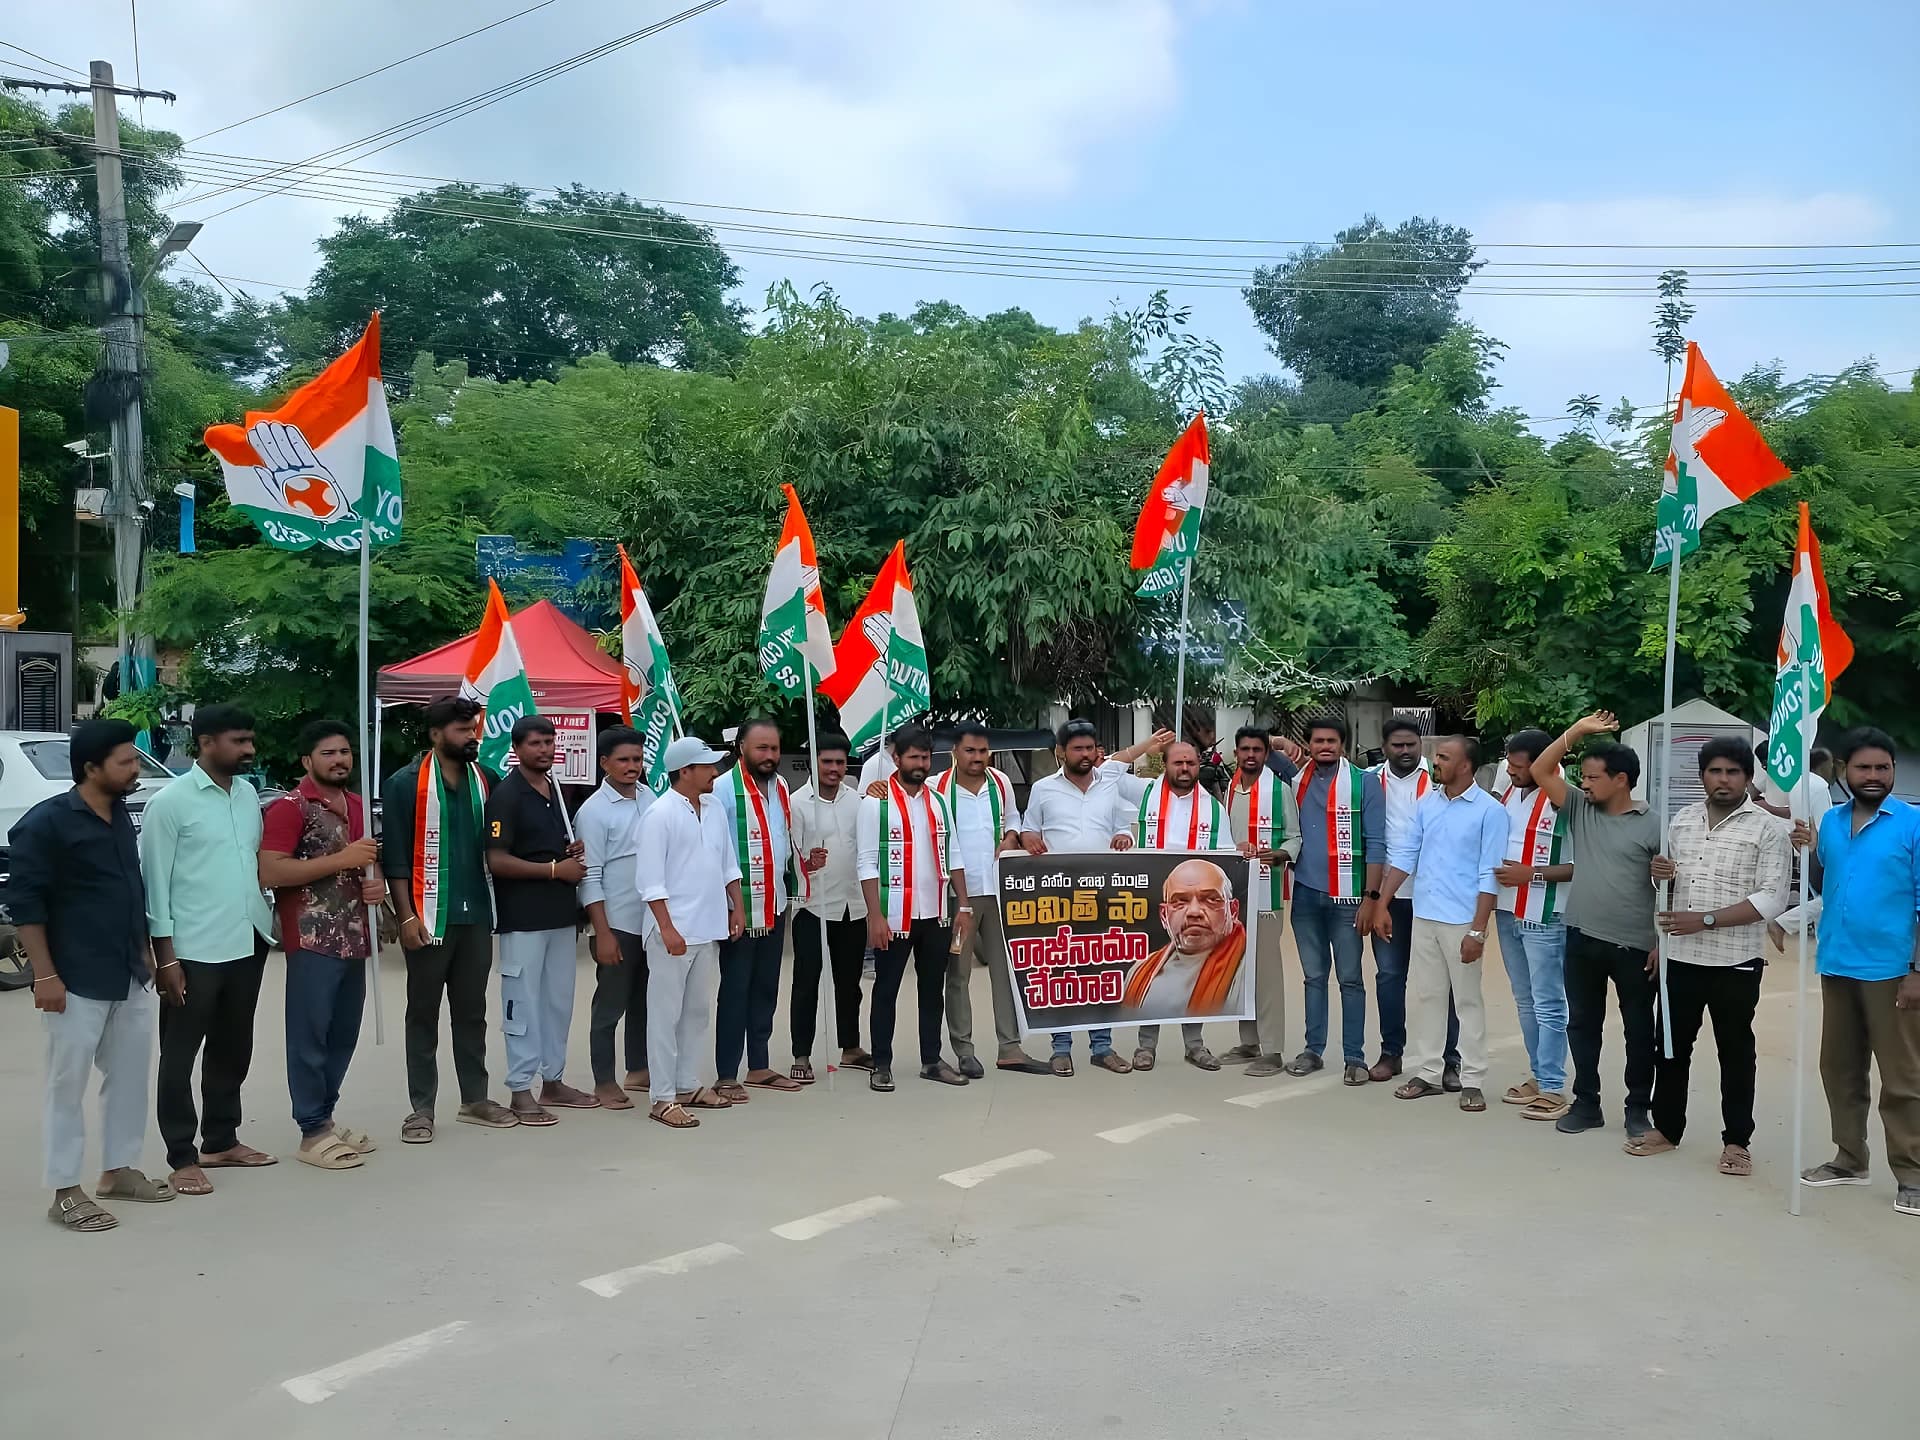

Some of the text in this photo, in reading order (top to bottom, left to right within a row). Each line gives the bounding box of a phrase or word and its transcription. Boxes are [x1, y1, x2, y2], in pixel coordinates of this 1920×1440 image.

[491, 821, 501, 838] 3
[1004, 874, 1035, 891] కేంద్ర
[1041, 872, 1071, 889] హోం
[1111, 872, 1149, 889] మంత్రి
[1006, 890, 1149, 926] అమిత్ షా
[1008, 924, 1149, 971] రాజీనామా
[1025, 966, 1124, 1010] చేయాలి
